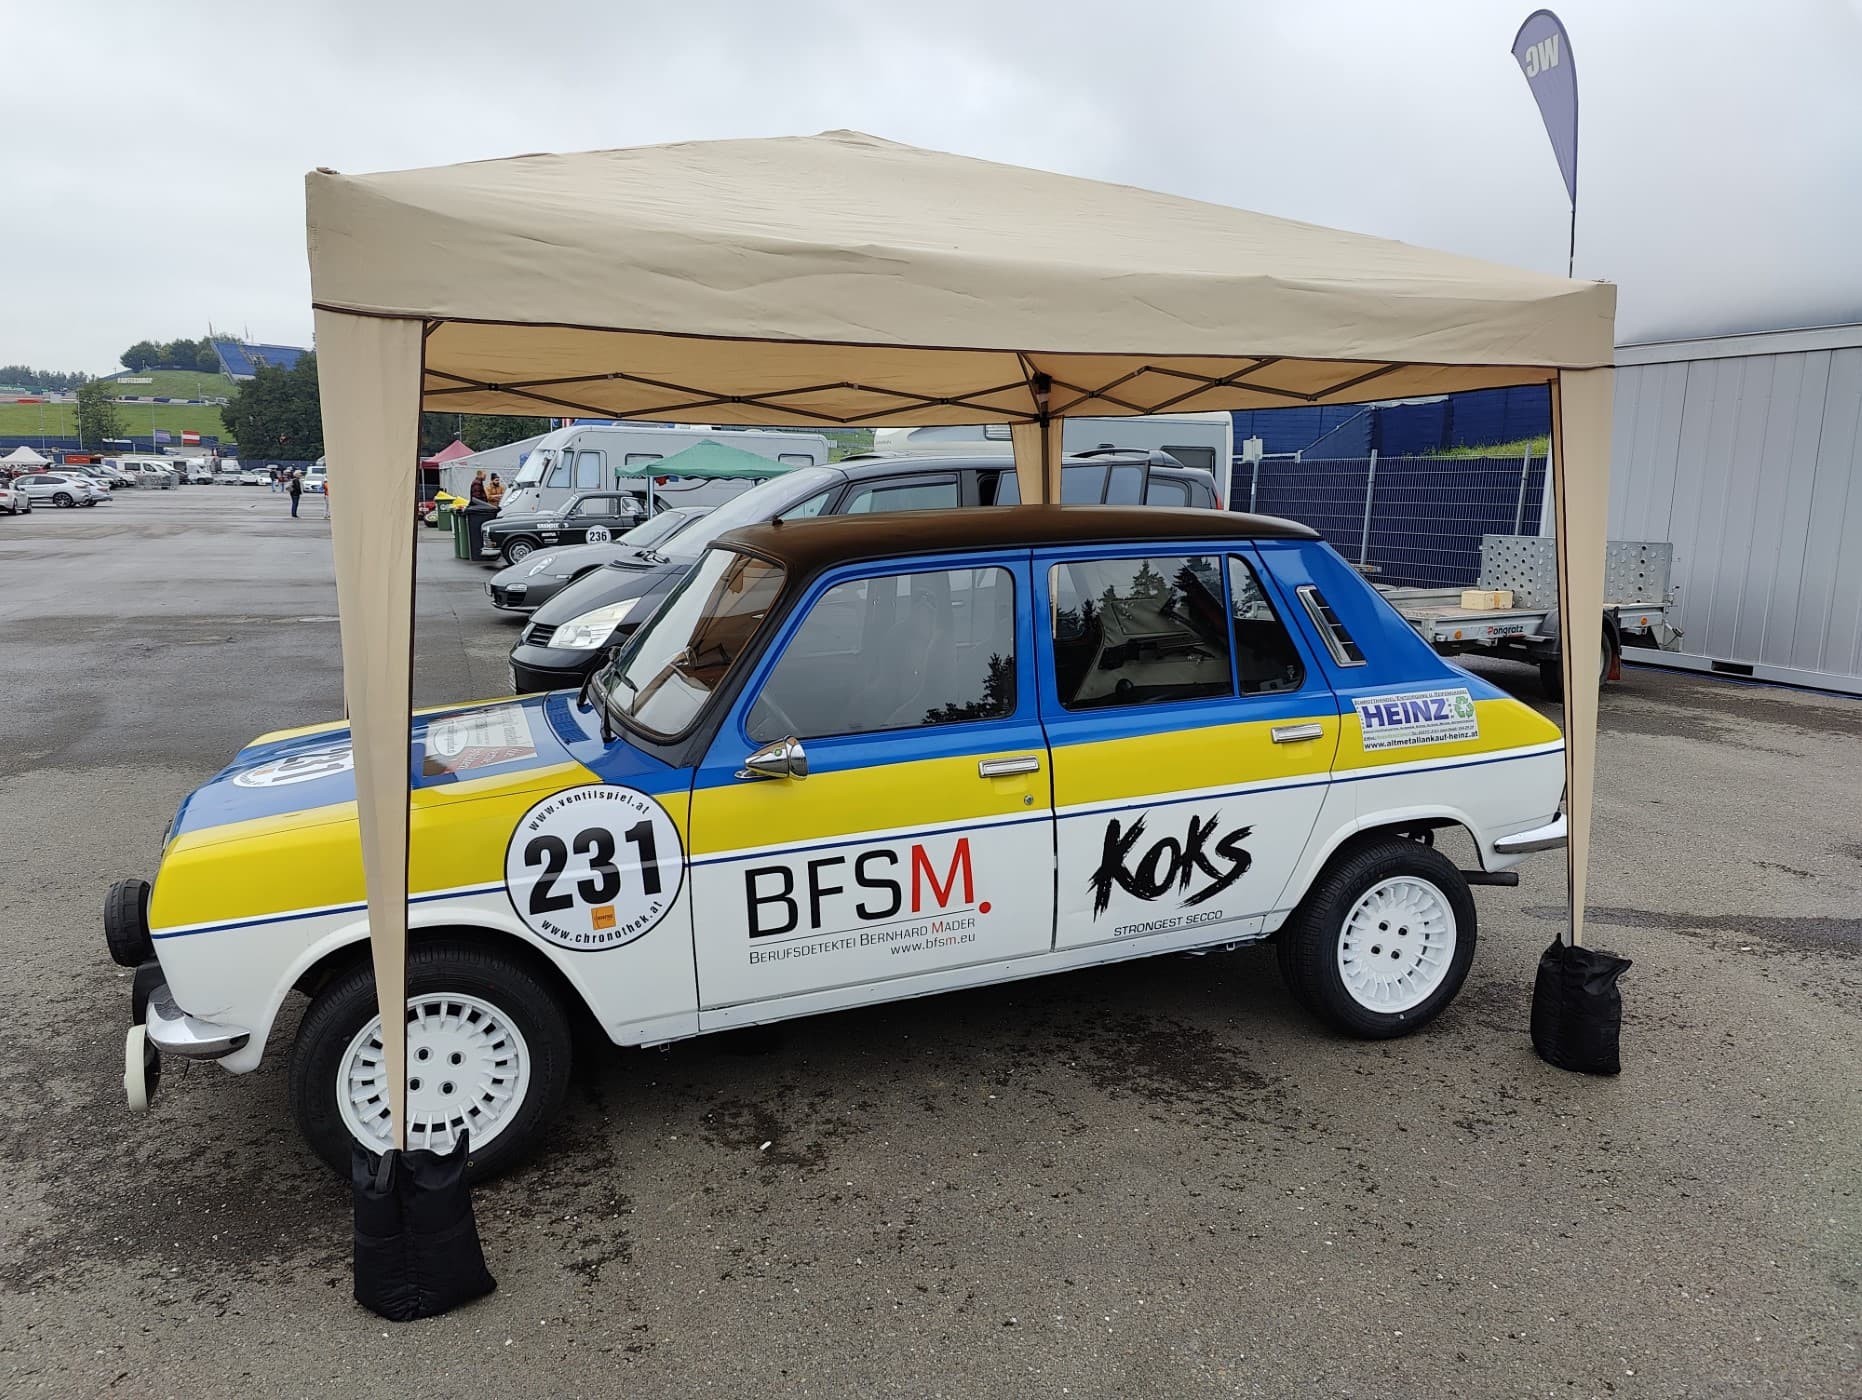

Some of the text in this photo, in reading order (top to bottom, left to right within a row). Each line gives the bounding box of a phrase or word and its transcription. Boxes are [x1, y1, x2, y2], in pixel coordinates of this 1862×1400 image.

[589, 531, 607, 542] 236
[1361, 698, 1450, 728] HEINZ
[528, 789, 650, 832] www.ventilspiel.at
[524, 819, 662, 916] 231
[541, 900, 663, 944] www.chronothek.at
[1113, 910, 1223, 937] STRONGEST SECCO
[890, 932, 976, 955] www.bfsm.eu
